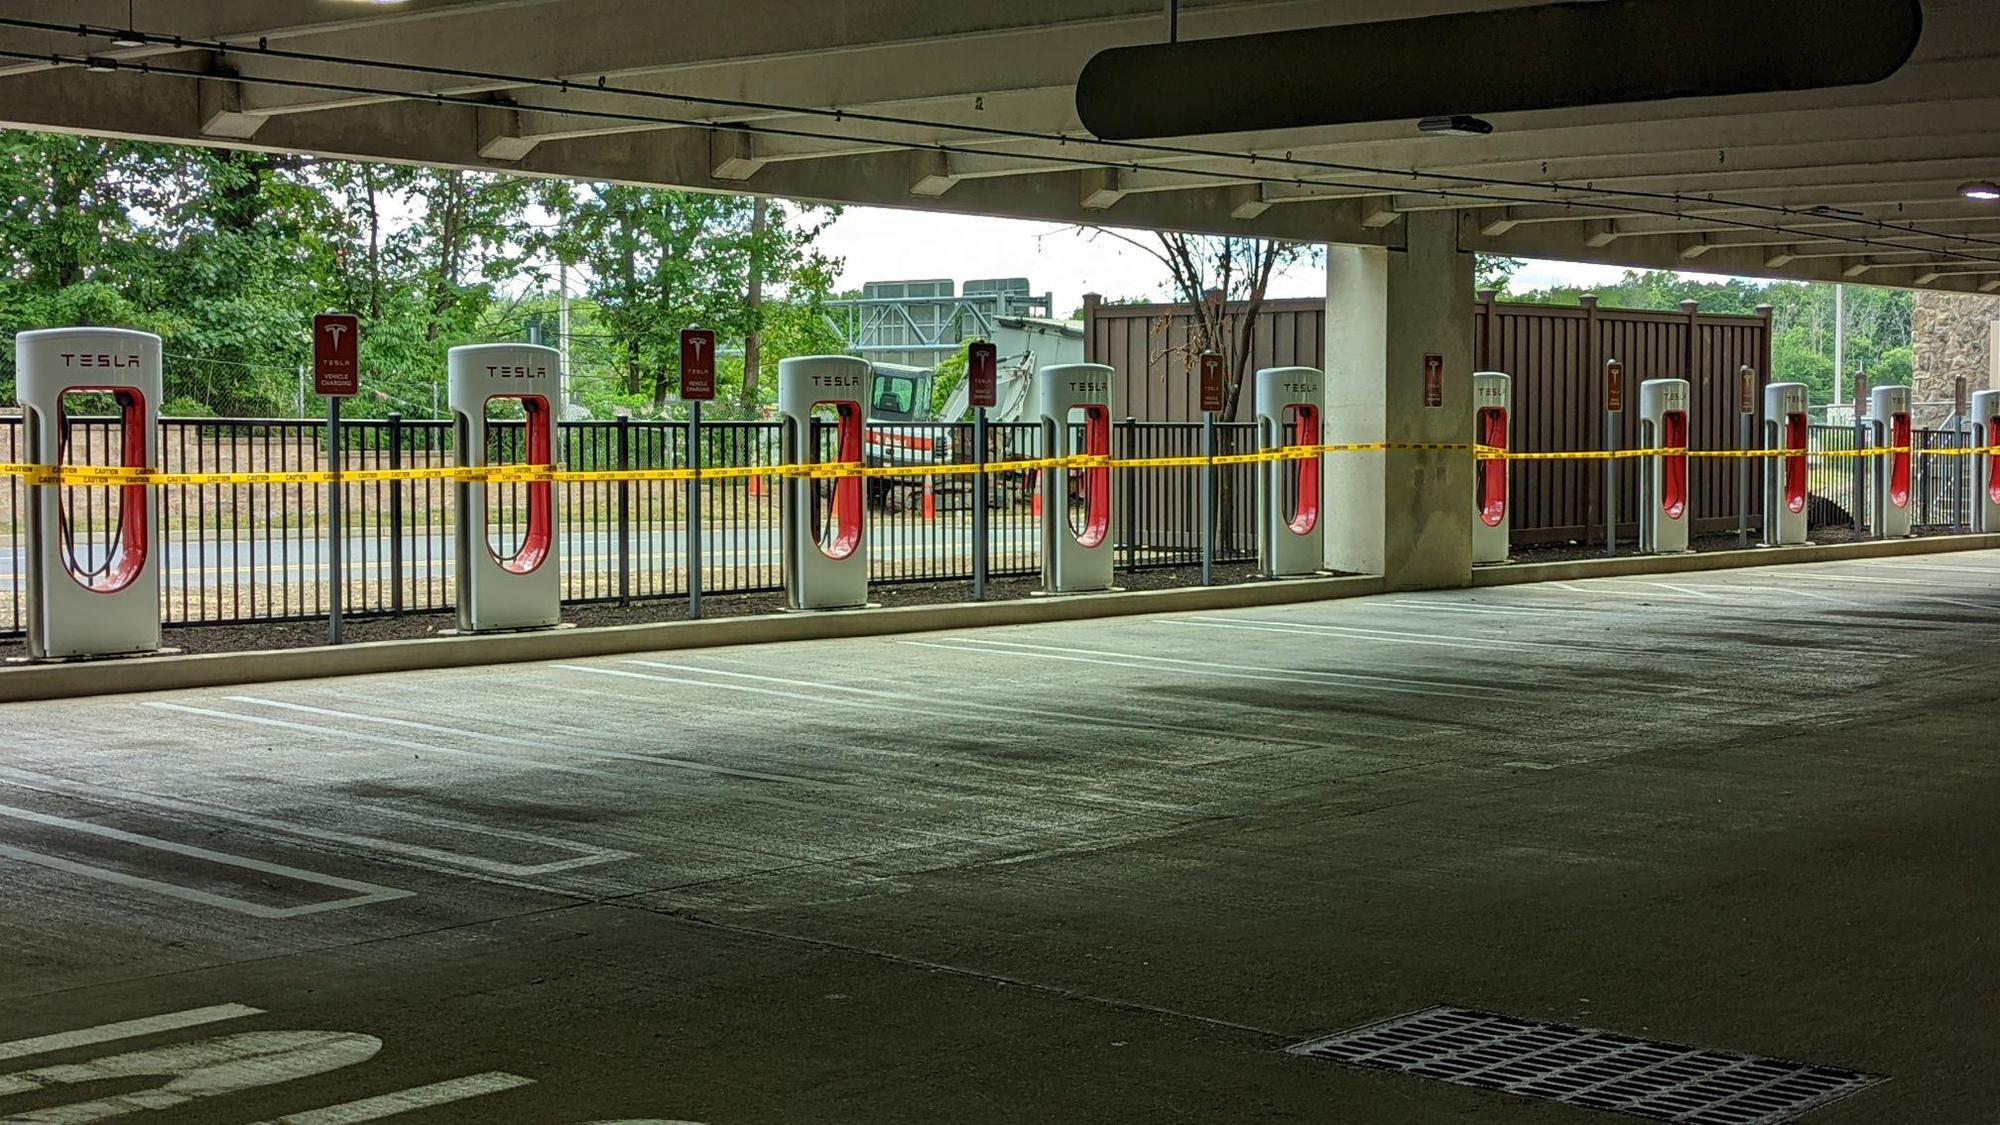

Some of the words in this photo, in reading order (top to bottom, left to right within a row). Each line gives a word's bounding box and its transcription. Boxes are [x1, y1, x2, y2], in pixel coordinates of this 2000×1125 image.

[61, 354, 139, 367] TESLA
[486, 366, 546, 378] TESLA
[812, 376, 859, 387] TESLA
[1069, 382, 1108, 392] TESLA
[1284, 383, 1318, 393] TESLA
[5, 465, 33, 473] CAUTION
